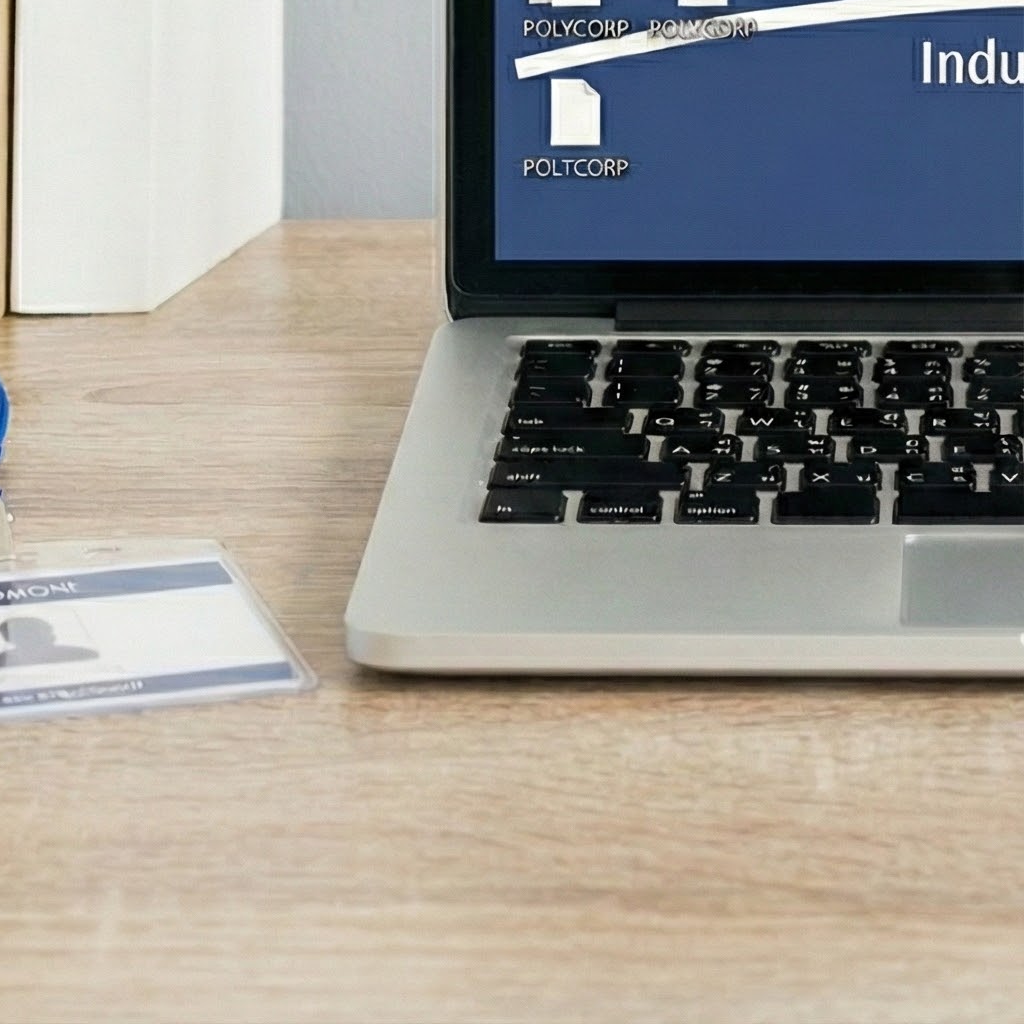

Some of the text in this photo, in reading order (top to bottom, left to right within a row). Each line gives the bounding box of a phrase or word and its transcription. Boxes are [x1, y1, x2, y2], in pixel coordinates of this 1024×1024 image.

[523, 19, 630, 39] POLYCORP
[922, 36, 1024, 85] Indu
[523, 158, 629, 177] POLTCORP
